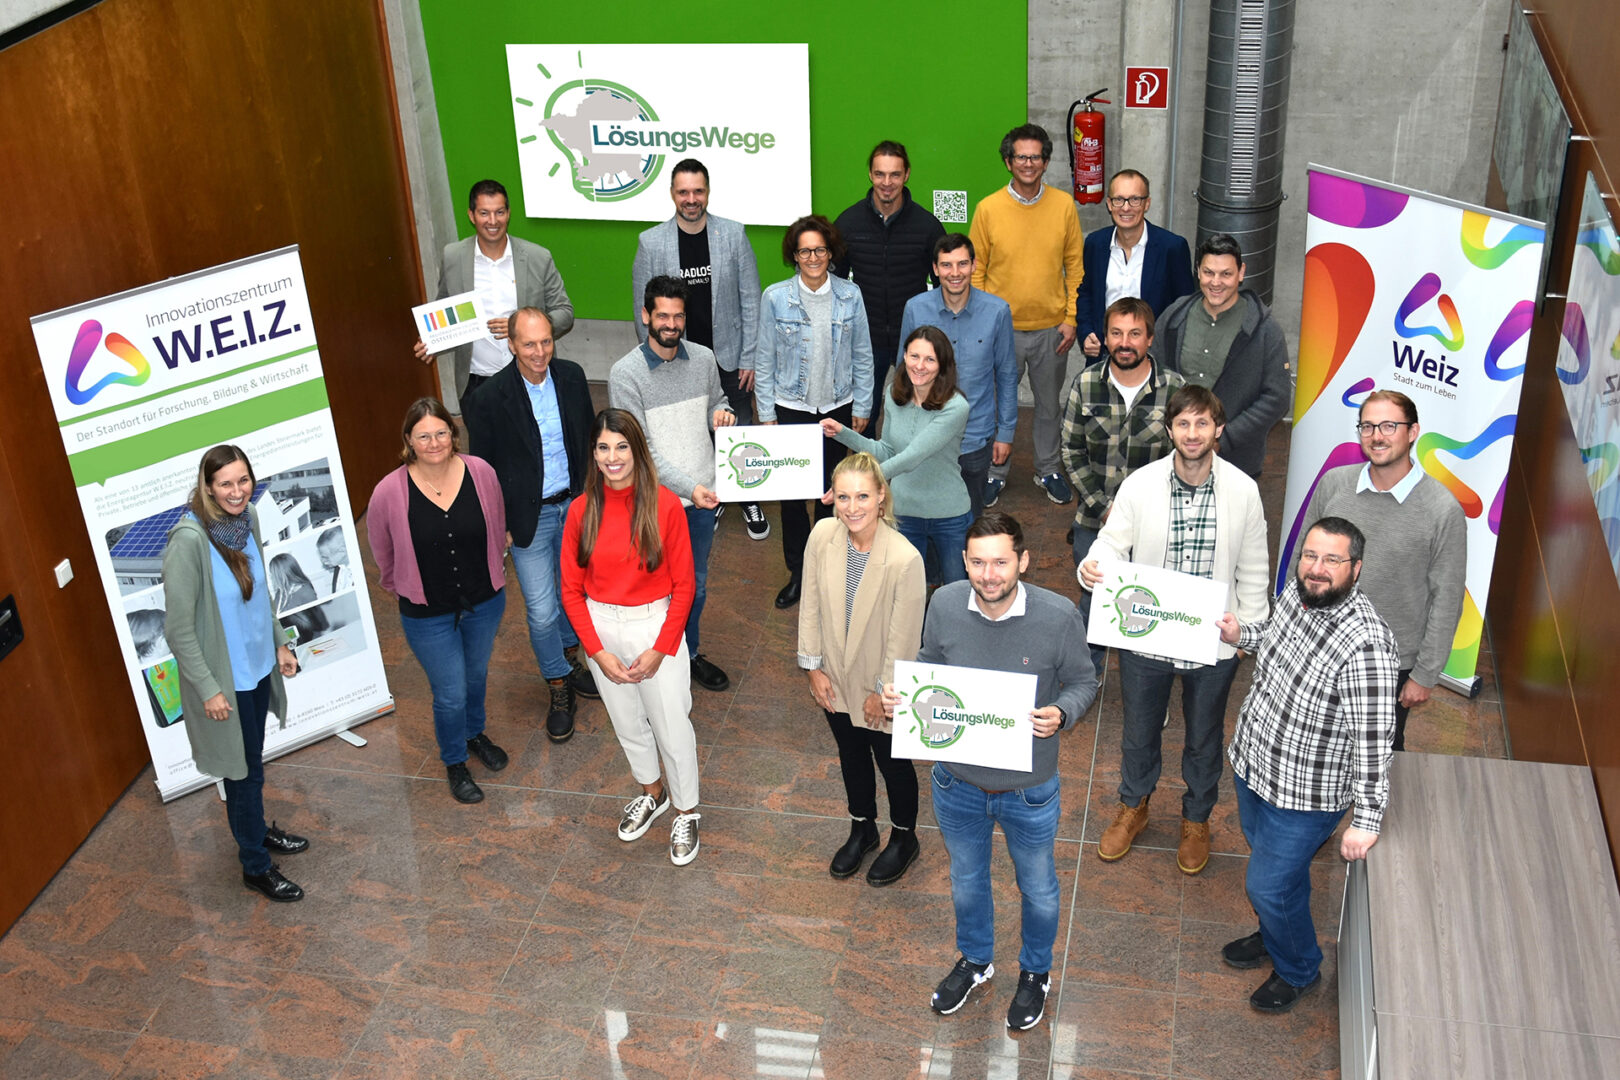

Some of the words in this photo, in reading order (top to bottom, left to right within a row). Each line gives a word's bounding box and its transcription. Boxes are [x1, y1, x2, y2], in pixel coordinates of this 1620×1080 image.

[592, 124, 776, 155] LösungsWege
[146, 276, 293, 328] Innovationszentrum
[152, 299, 302, 370] W.E.I.Z.
[1392, 340, 1460, 388] Weiz
[1393, 372, 1414, 387] Stadt
[1415, 381, 1433, 392] zum
[1434, 385, 1457, 400] Leben
[76, 429, 94, 443] Der
[96, 416, 142, 437] Standort
[143, 410, 157, 423] für
[158, 393, 212, 419] Forschung,
[212, 381, 249, 401] Bildung
[250, 377, 259, 389] &
[259, 363, 310, 385] Wirtschaft
[745, 457, 811, 469] LösungsWege
[1131, 603, 1202, 626] LösungsWege
[932, 707, 1016, 730] LösungsWege
